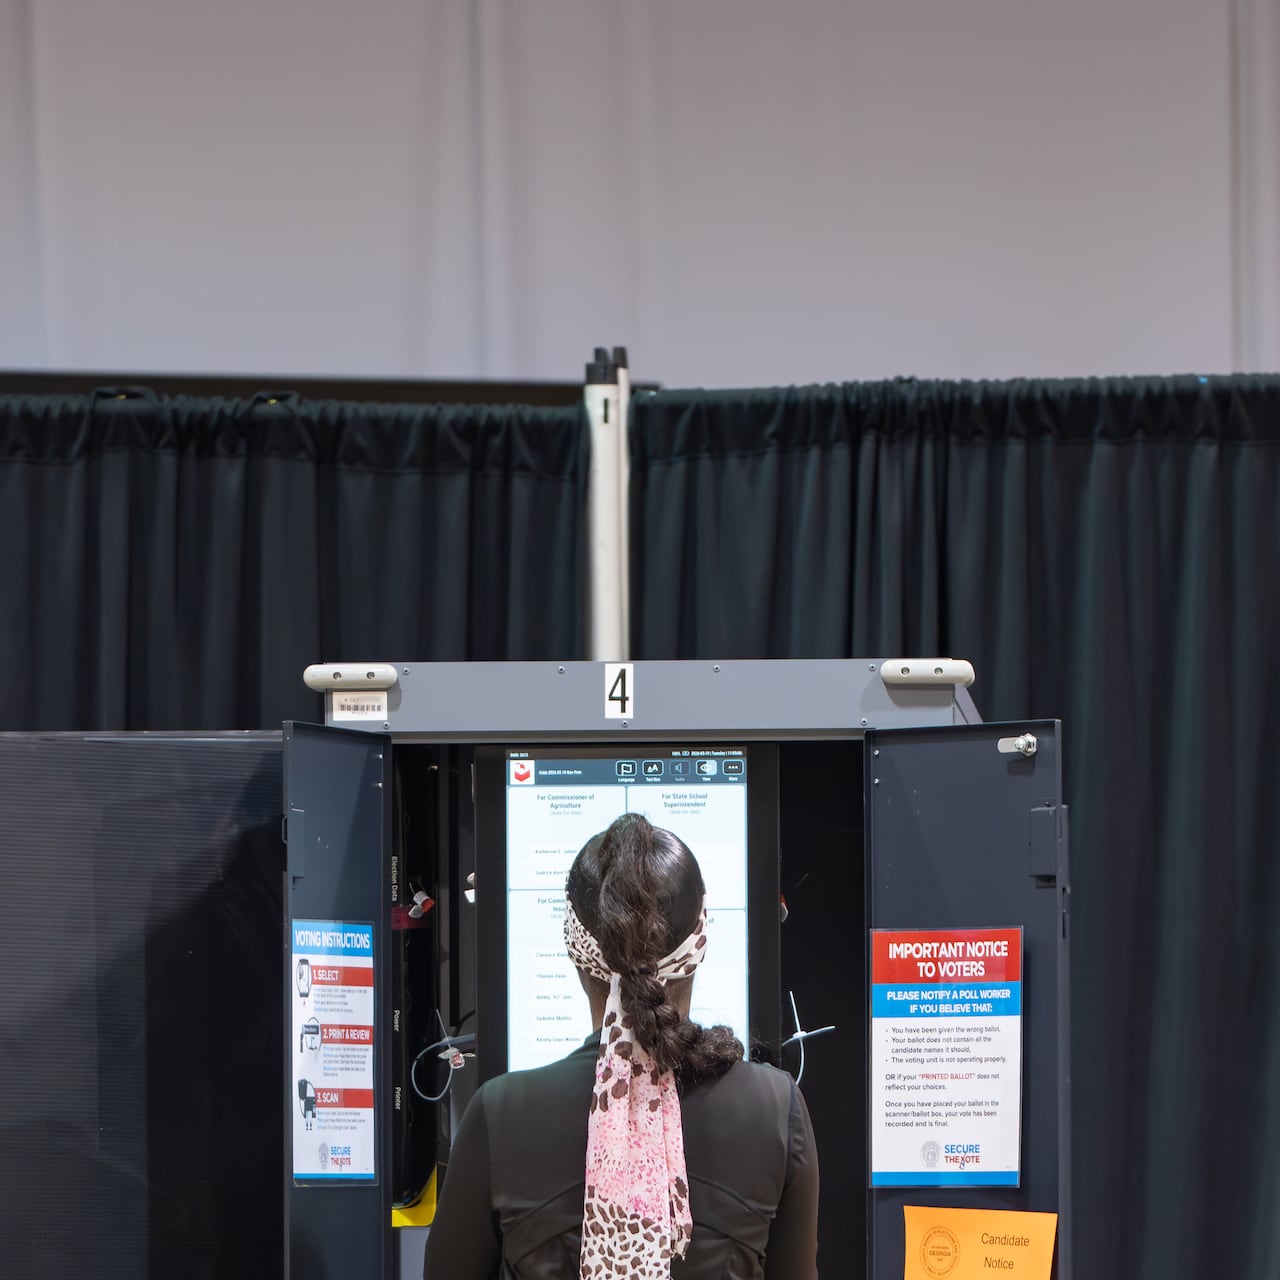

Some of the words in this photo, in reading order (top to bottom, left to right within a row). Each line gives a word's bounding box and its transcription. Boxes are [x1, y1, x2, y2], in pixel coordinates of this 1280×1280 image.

[608, 668, 629, 713] 4
[391, 856, 399, 884] Election
[391, 885, 399, 902] Data
[295, 930, 320, 947] VOTING
[321, 931, 370, 949] INSTRUCTIONS
[888, 942, 964, 959] IMPORTANT
[967, 941, 1008, 957] NOTICE
[313, 969, 317, 981] 1.
[318, 969, 339, 981] SELECT
[917, 962, 936, 978] TO
[938, 961, 985, 977] VOTERS
[887, 991, 919, 1000] PLEASE
[921, 990, 951, 1000] NOTIFY
[951, 990, 959, 999] A
[960, 990, 978, 999] POLL
[980, 989, 1011, 999] WORKER
[910, 1004, 918, 1013] IF
[919, 1004, 938, 1013] YOU
[939, 1003, 970, 1013] BELIEVE
[972, 1003, 993, 1012] THAT:
[322, 1028, 328, 1040] 2.
[329, 1028, 345, 1040] PRINT
[345, 1028, 350, 1040] &
[350, 1029, 371, 1040] REVIEW
[957, 1056, 983, 1064] operating
[316, 1092, 322, 1103] 3.
[322, 1092, 339, 1103] SCAN
[330, 1146, 351, 1156] SECURE
[944, 1144, 980, 1154] SECURE
[330, 1157, 340, 1165] THE
[981, 1232, 1030, 1247] Candidate
[984, 1257, 1014, 1270] Notice
